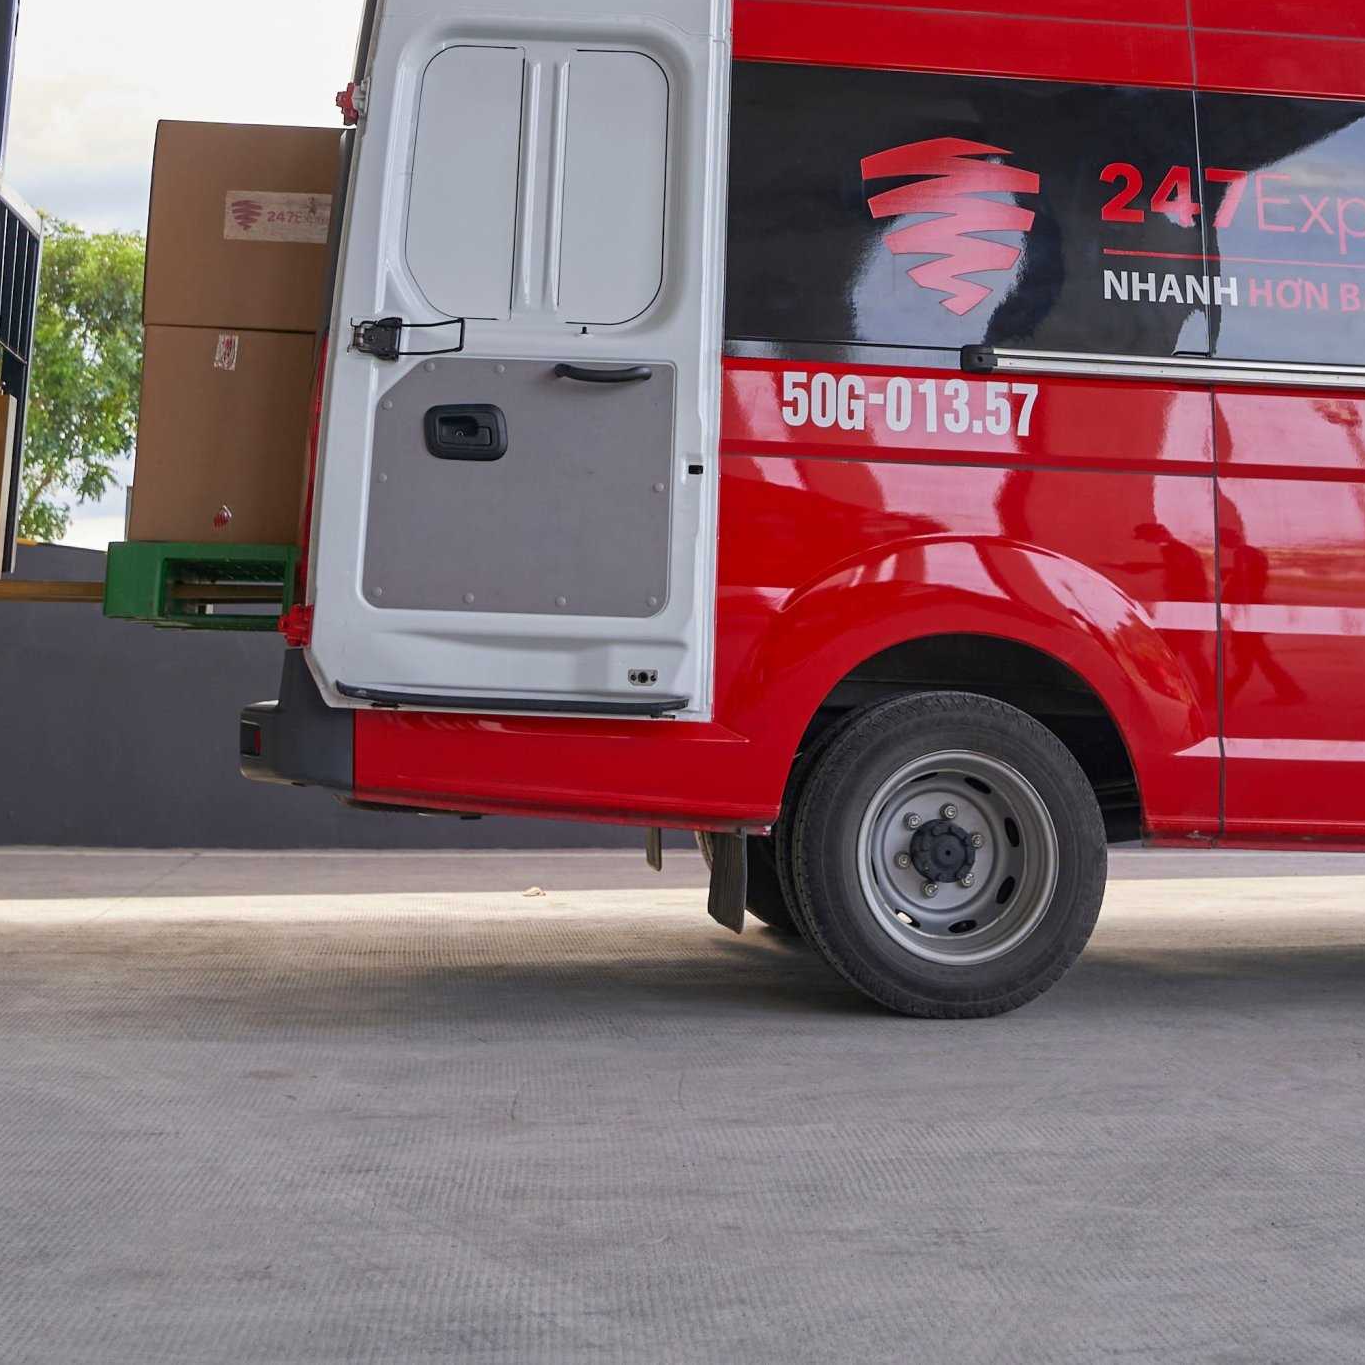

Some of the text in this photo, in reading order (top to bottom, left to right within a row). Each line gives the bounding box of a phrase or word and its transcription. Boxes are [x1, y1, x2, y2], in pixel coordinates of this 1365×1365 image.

[1103, 269, 1238, 306] NHANH
[1248, 277, 1329, 311] HƠN
[782, 371, 1039, 437] 50G-013.57
